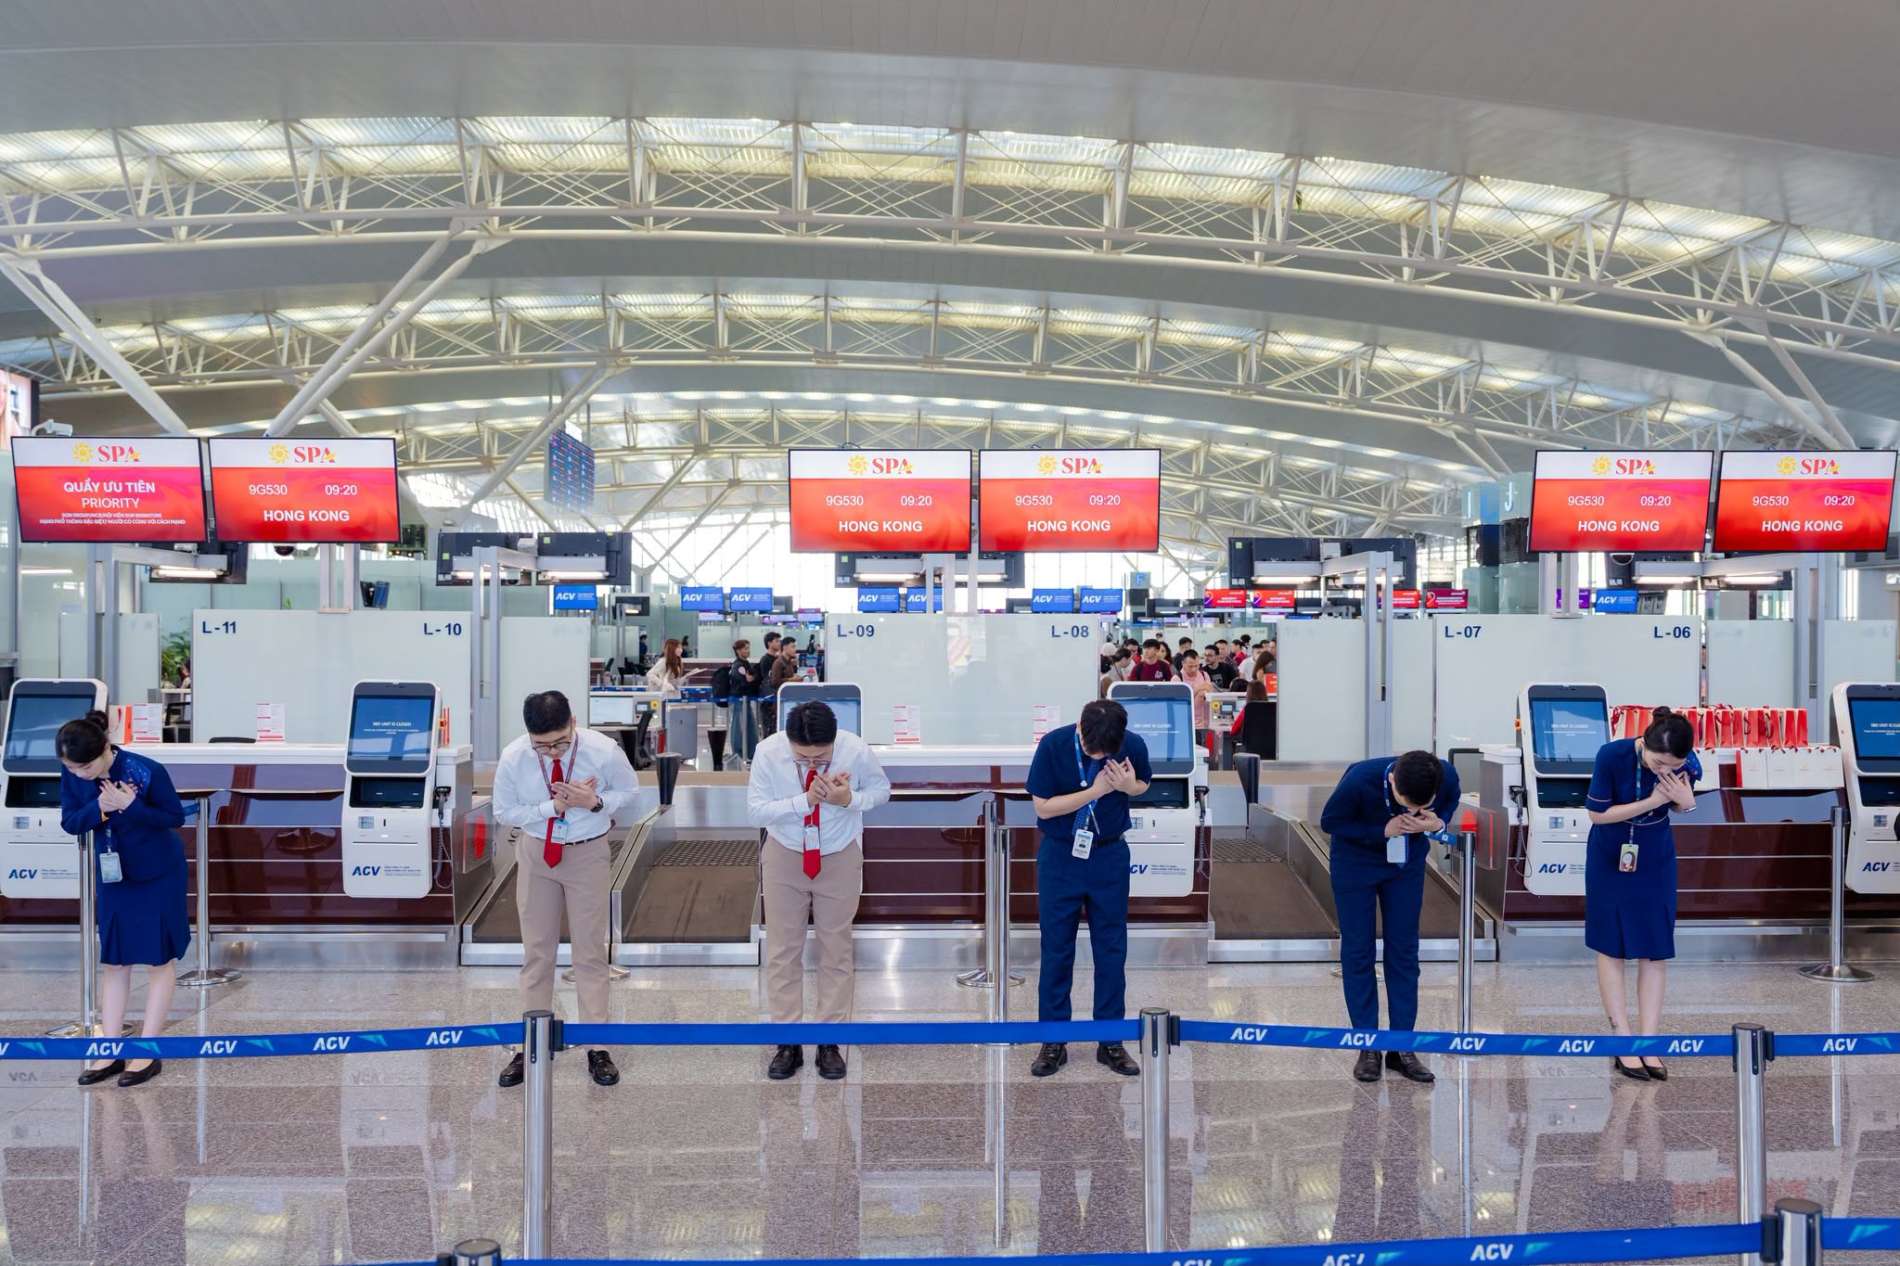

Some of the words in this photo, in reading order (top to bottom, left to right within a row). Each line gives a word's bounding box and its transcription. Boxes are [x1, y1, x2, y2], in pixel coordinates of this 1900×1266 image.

[97, 445, 140, 463] SPA
[293, 446, 336, 463] SPA
[871, 457, 914, 474] SPA
[1061, 457, 1103, 474] SPA
[1615, 458, 1656, 475] SPA
[1800, 458, 1841, 475] SPA
[125, 478, 156, 493] TIÊN
[249, 484, 288, 496] 9G530
[324, 484, 358, 496] 09:20
[81, 497, 140, 509] PRIORITY
[826, 495, 864, 506] 9G530
[900, 495, 933, 506] 09:20
[1015, 494, 1053, 506] 9G530
[1089, 494, 1121, 506] 09:20
[1567, 495, 1605, 507] 9G530
[1640, 495, 1672, 507] 09:20
[1752, 495, 1790, 507] 9G530
[1824, 495, 1856, 507] 09:20
[263, 509, 305, 522] HONG
[308, 509, 350, 522] KONG
[838, 520, 879, 532] HONG
[882, 520, 923, 532] KONG
[1027, 520, 1068, 532] HONG
[1071, 519, 1111, 532] KONG
[1578, 519, 1618, 533] HONG
[1620, 519, 1661, 533] KONG
[1761, 519, 1802, 532] HONG
[1804, 519, 1844, 532] KONG
[556, 592, 576, 601] ACV
[683, 593, 703, 602] ACV
[731, 593, 752, 602] ACV
[859, 594, 879, 603] ACV
[1033, 594, 1054, 604] ACV
[1081, 594, 1102, 604] ACV
[1597, 596, 1618, 604] ACV
[202, 621, 236, 634] L-11
[423, 622, 462, 636] L-10
[837, 624, 875, 638] L-09
[1051, 624, 1089, 638] L-08
[1444, 625, 1482, 639] L-07
[1653, 626, 1691, 639] L-06
[351, 865, 381, 877] ACV
[1130, 864, 1149, 875] CV
[1538, 863, 1567, 874] ACV
[1862, 861, 1891, 872] ACV
[8, 868, 38, 880] ACV
[425, 1030, 463, 1046] ACV
[1230, 1028, 1268, 1042] ACV
[1339, 1032, 1377, 1047] ACV
[86, 1042, 124, 1056] ACV
[200, 1040, 238, 1055] ACV
[312, 1036, 350, 1051] ACV
[1449, 1037, 1486, 1051] ACV
[1558, 1039, 1595, 1053] ACV
[1667, 1039, 1704, 1053] ACV
[1822, 1038, 1858, 1052] ACV
[1470, 1243, 1514, 1261] ACV
